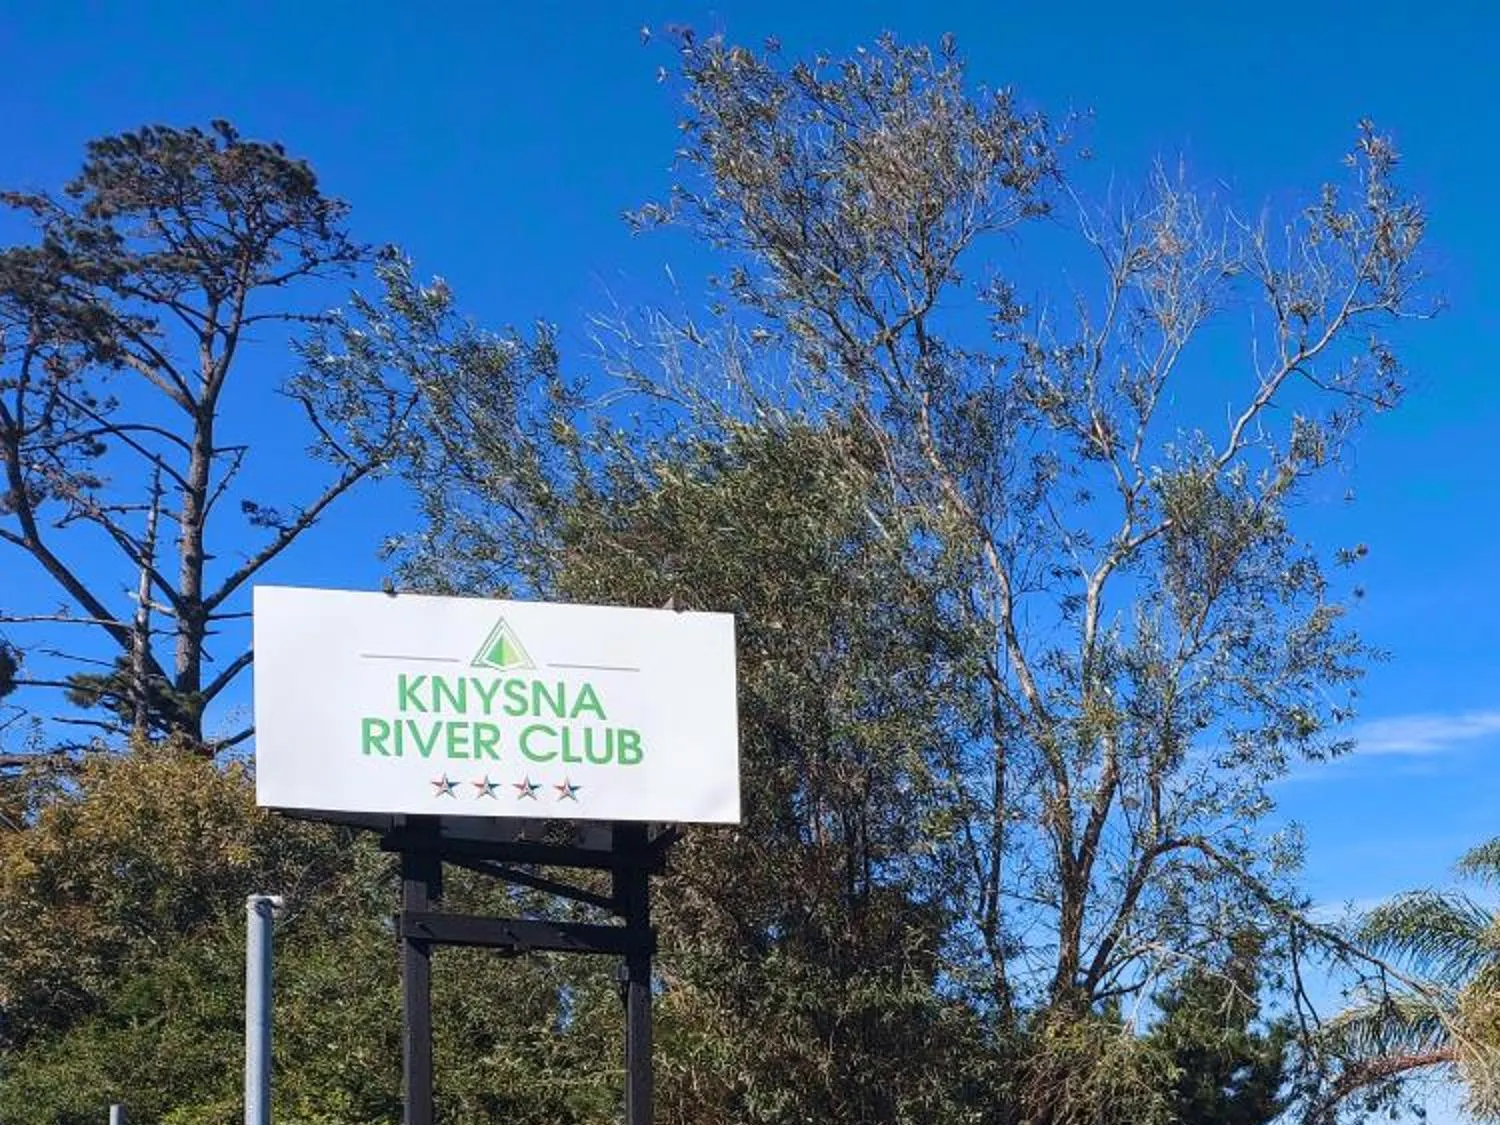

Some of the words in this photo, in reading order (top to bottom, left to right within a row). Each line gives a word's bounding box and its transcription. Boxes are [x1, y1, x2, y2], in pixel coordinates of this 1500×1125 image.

[398, 674, 606, 720] KNYSNA
[361, 718, 501, 760] RIVER
[518, 723, 644, 765] CLUB
